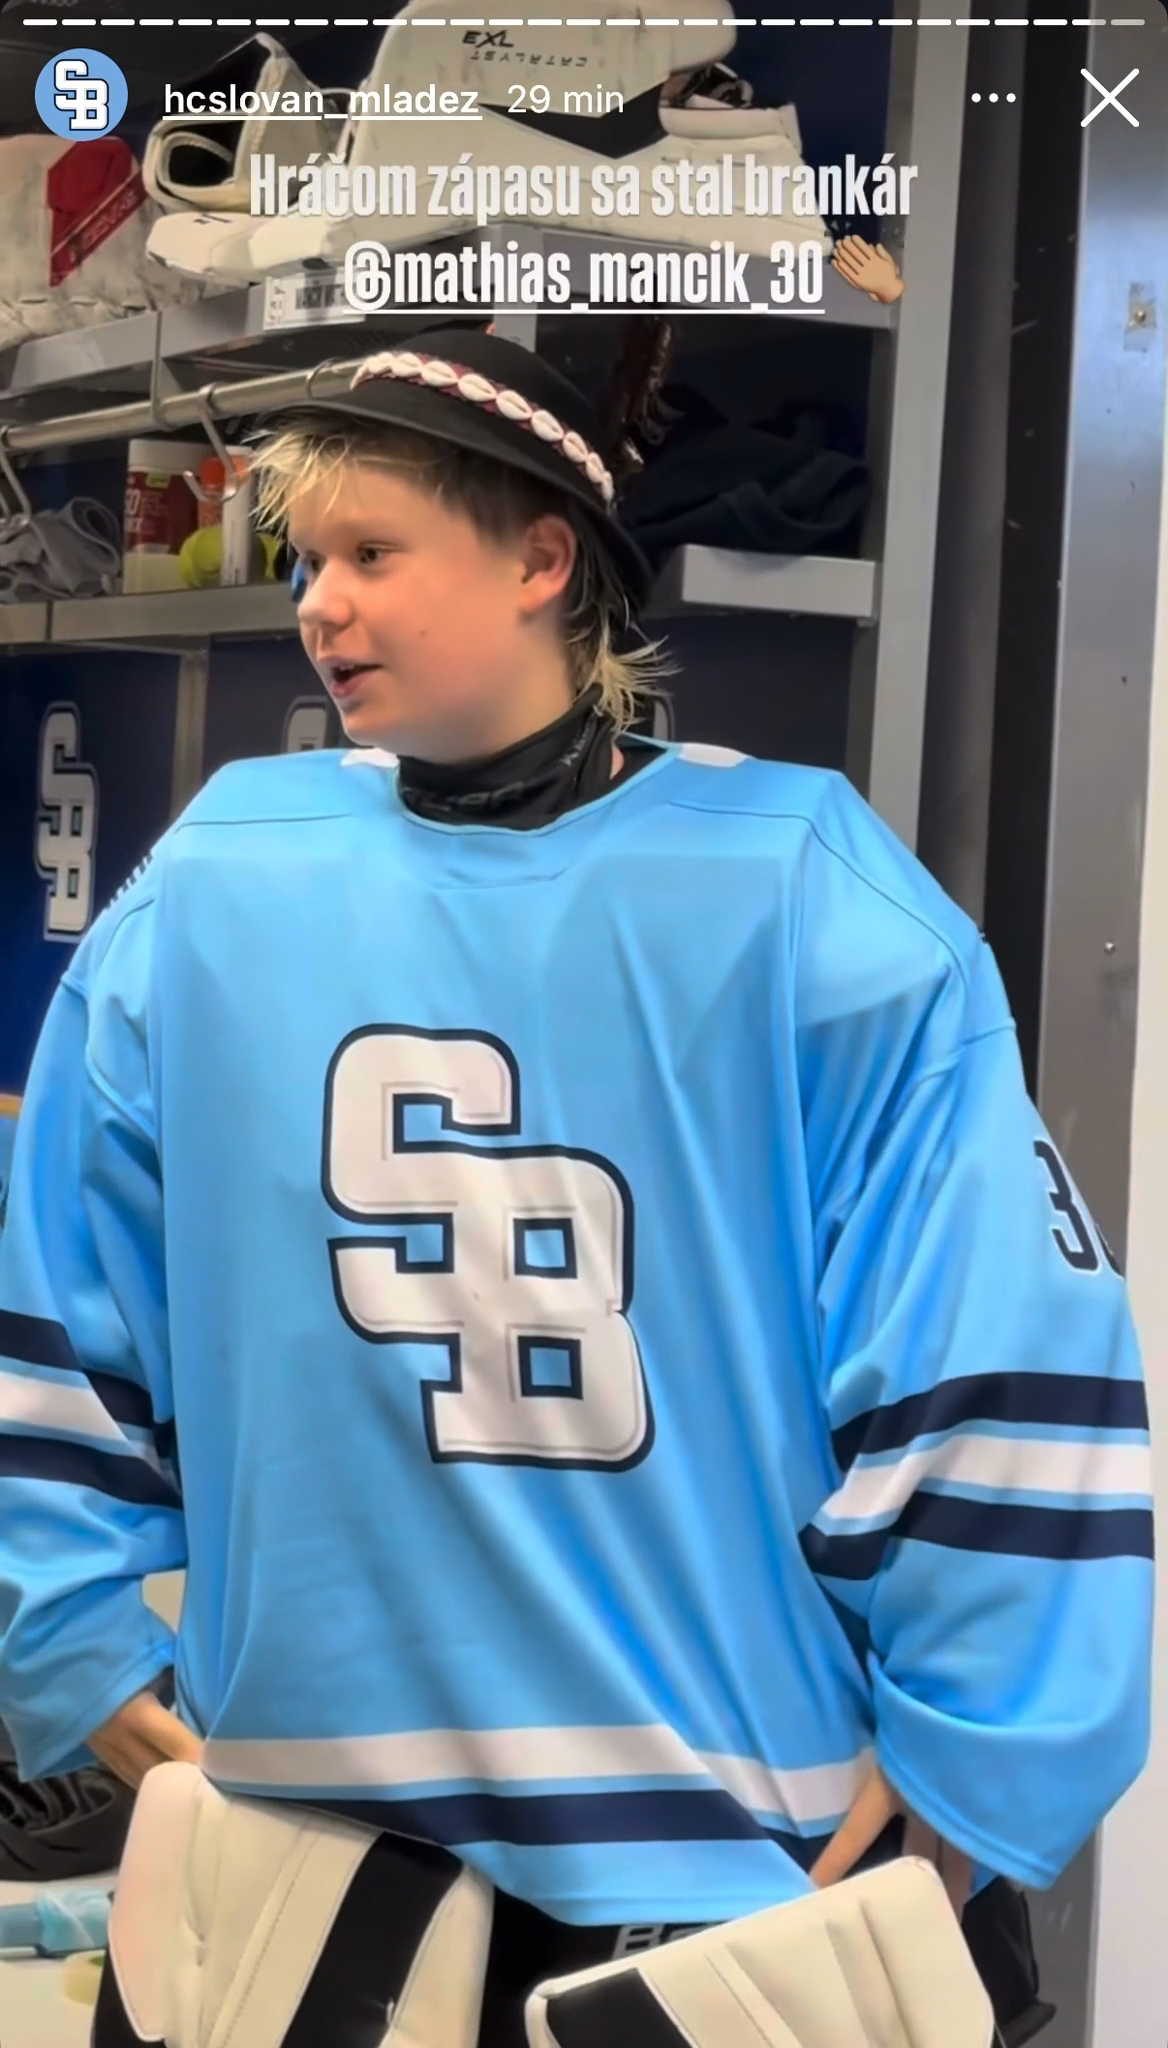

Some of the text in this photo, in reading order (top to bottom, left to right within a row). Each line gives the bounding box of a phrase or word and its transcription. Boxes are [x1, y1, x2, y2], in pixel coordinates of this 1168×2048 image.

[461, 29, 514, 49] EXL
[470, 50, 588, 67] CATALYST
[321, 1023, 656, 1473] SB
[1032, 1139, 1127, 1278] 3
